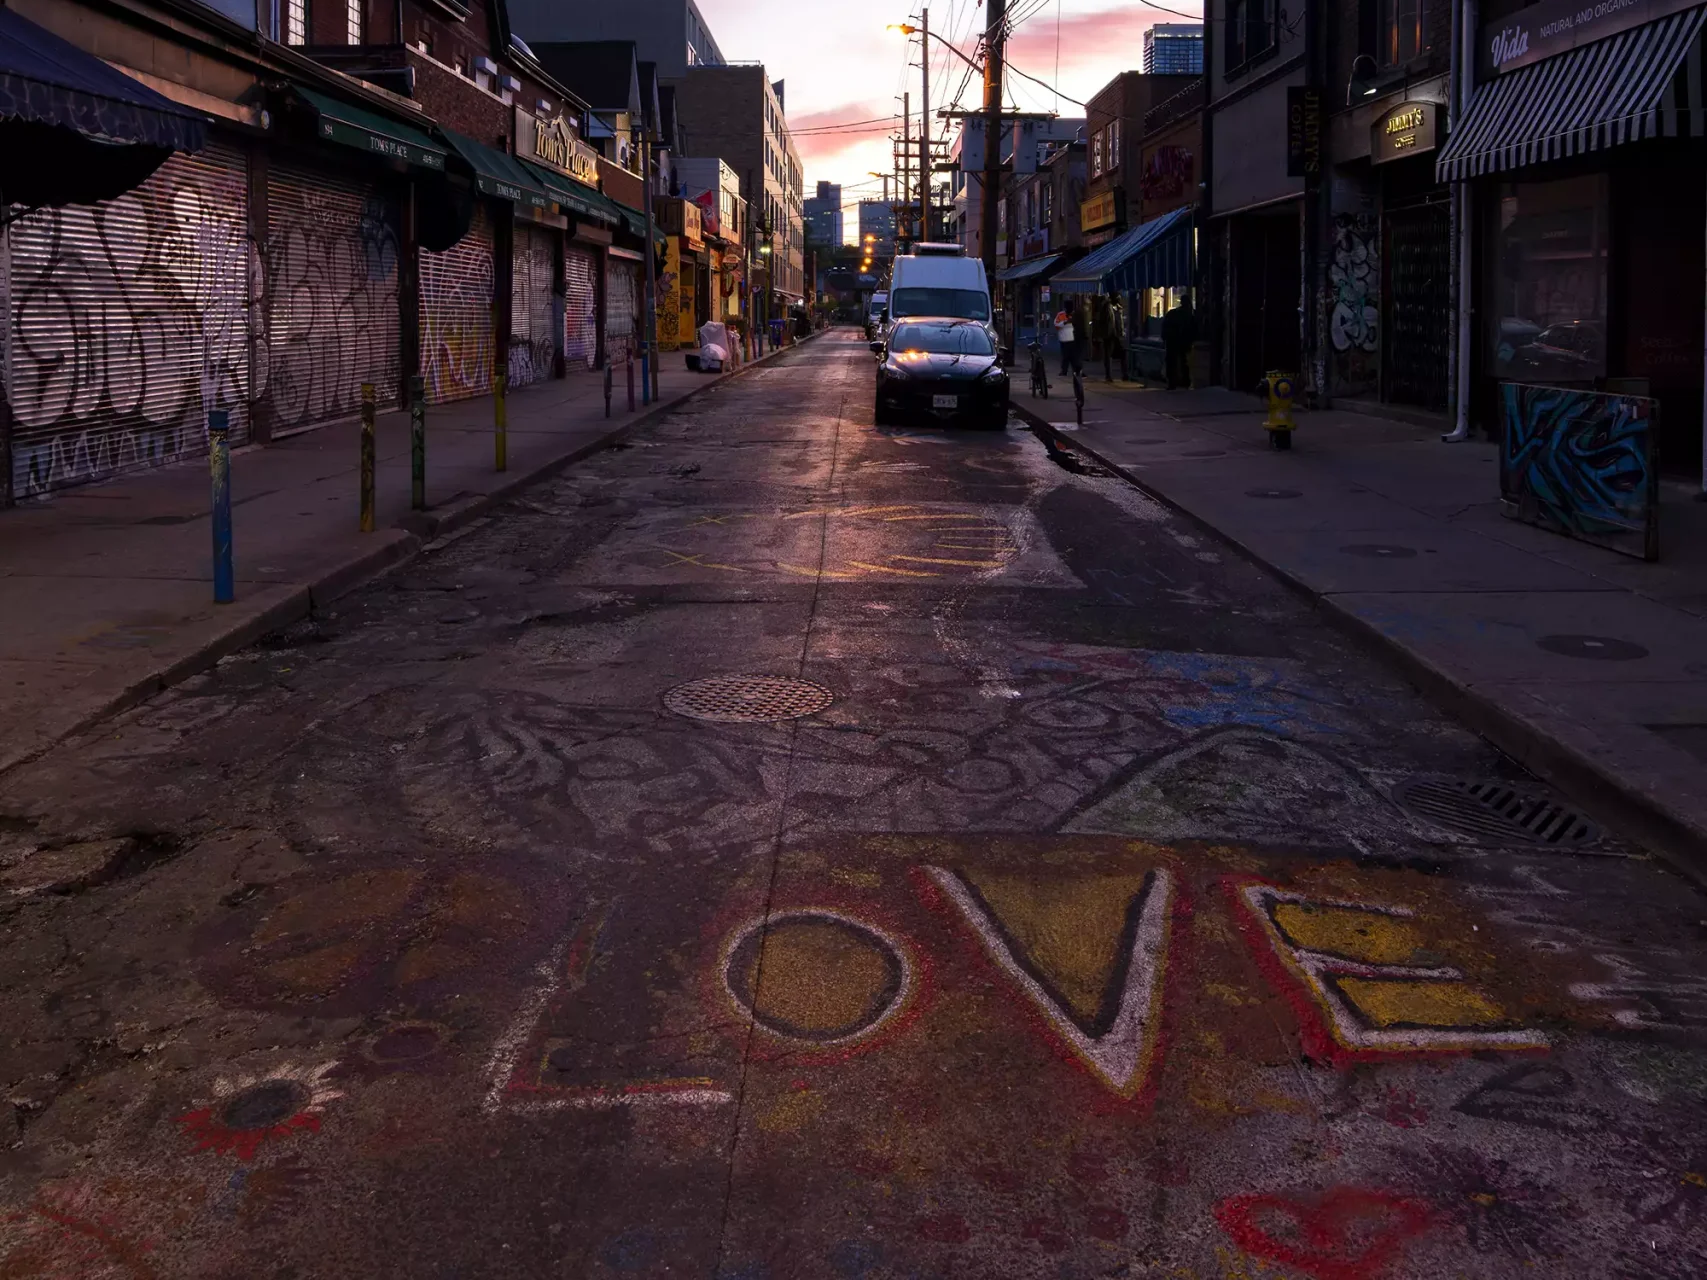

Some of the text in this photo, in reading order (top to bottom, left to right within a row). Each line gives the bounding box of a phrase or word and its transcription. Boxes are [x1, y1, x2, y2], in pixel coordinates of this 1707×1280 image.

[1491, 25, 1529, 68] Vida
[1540, 18, 1574, 38] NATURAL
[1575, 8, 1593, 25] AND
[1291, 104, 1303, 157] COFFEE
[1304, 91, 1320, 173] JIMMY'S
[1386, 108, 1423, 134] JIMMY'S
[370, 136, 408, 158] TOM'S PLACE
[535, 120, 590, 178] Tom's Place
[482, 864, 1553, 1114] LOVE
